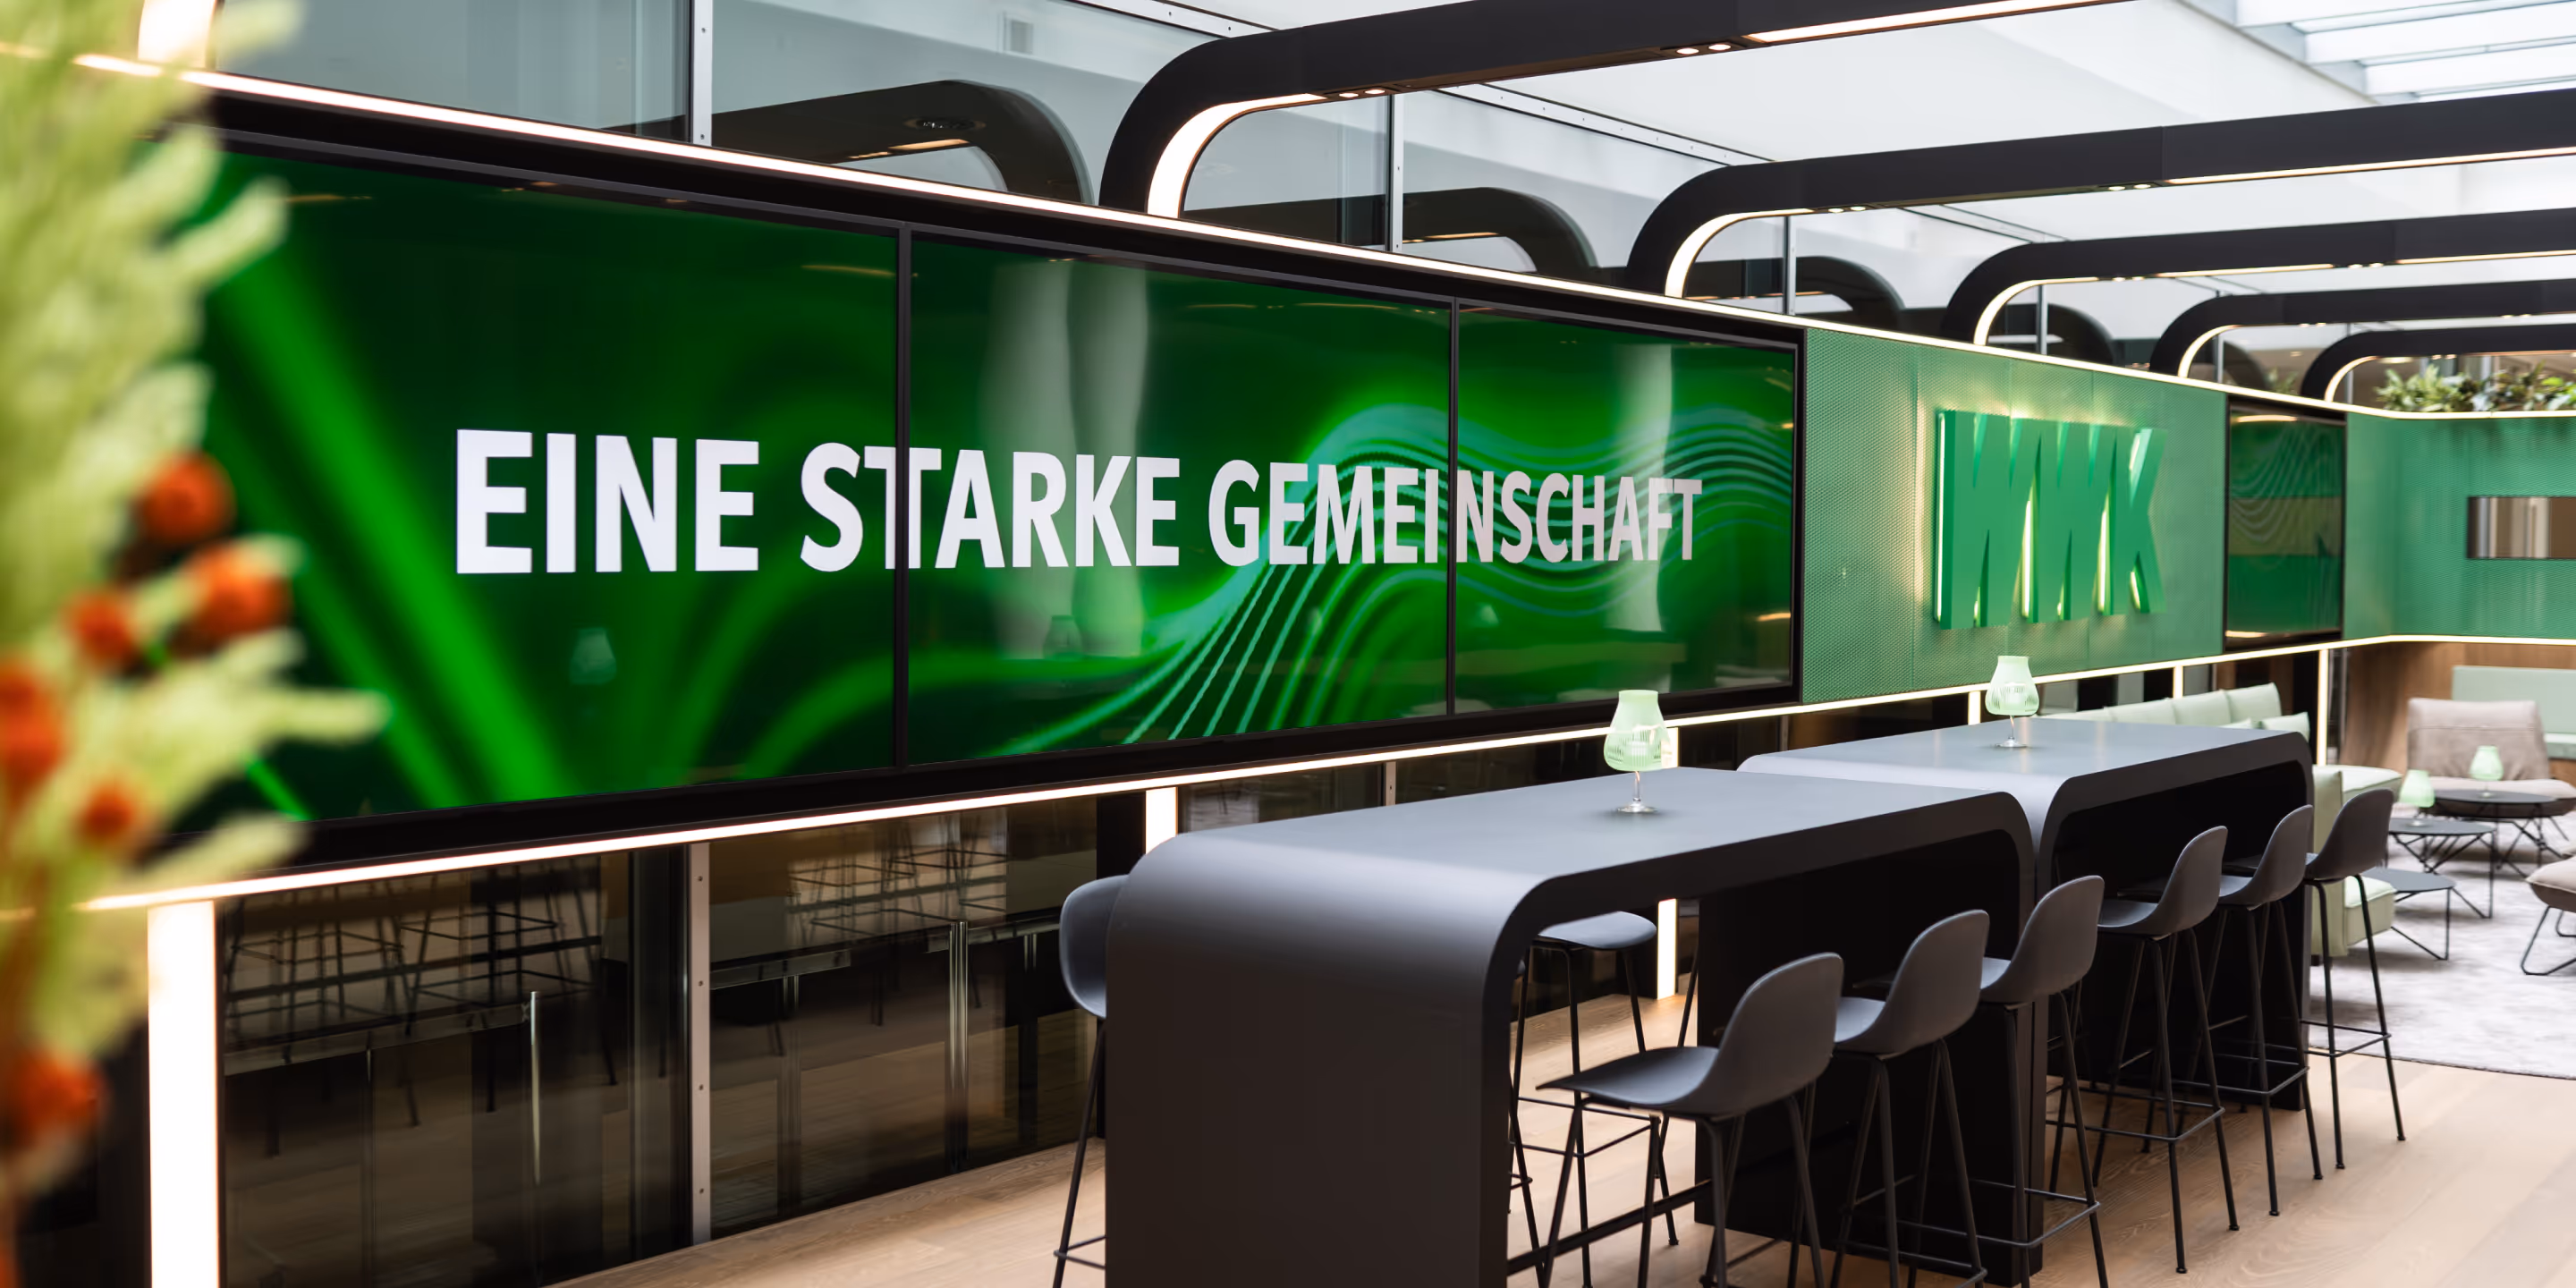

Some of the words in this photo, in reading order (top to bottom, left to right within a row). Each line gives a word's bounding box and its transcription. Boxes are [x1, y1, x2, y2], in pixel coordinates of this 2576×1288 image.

[456, 428, 758, 573] EINE
[801, 442, 1180, 572] STARKE
[1208, 459, 1702, 566] GEMEINSCHAFT
[1935, 409, 2168, 630] WWK
